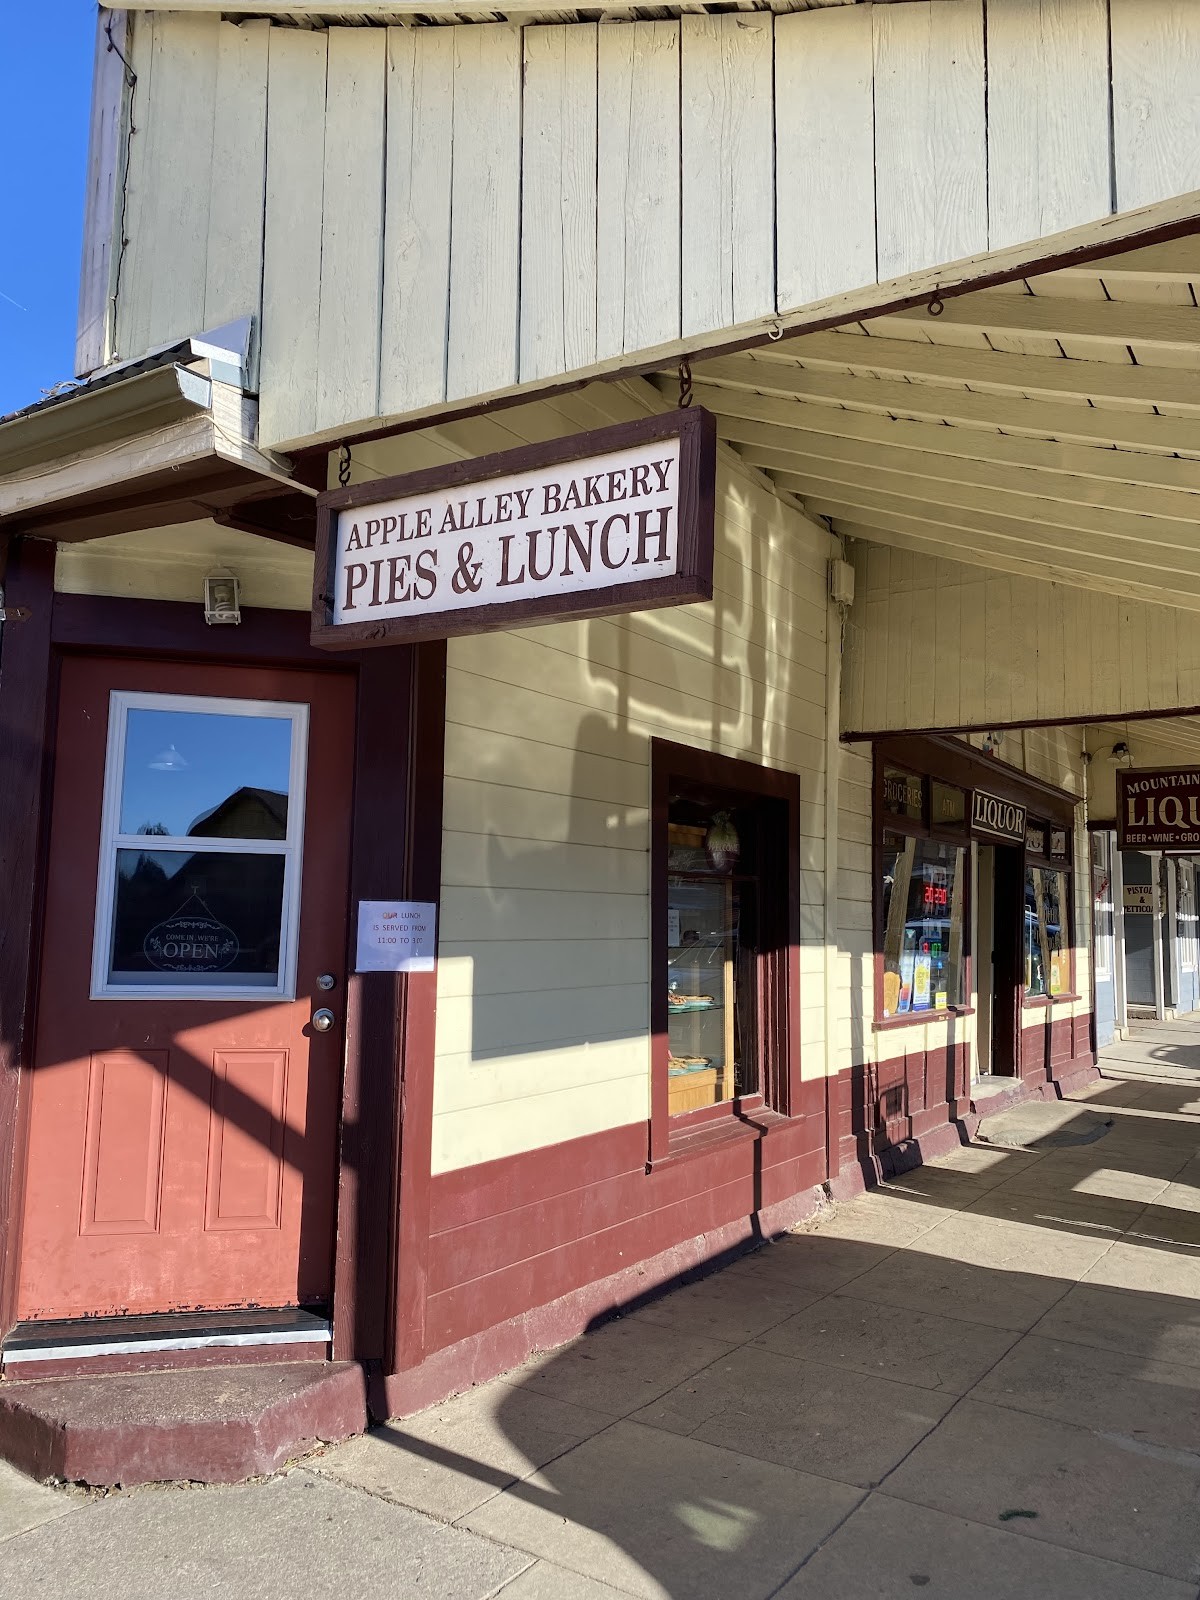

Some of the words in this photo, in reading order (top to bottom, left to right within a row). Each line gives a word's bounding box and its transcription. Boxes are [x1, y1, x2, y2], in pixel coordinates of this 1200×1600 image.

[345, 508, 432, 552] APPLE
[438, 488, 534, 535] ALLEY
[541, 458, 674, 515] BAKERY
[342, 548, 438, 610] PIES
[451, 541, 483, 595] &
[496, 506, 673, 587] LUNCH
[1126, 774, 1200, 795] MOUNTAIN
[975, 795, 1023, 833] LIQUOR
[1126, 833, 1147, 843] BEER
[1152, 832, 1175, 843] WINE
[166, 933, 186, 941] COME
[163, 942, 219, 959] OPEN
